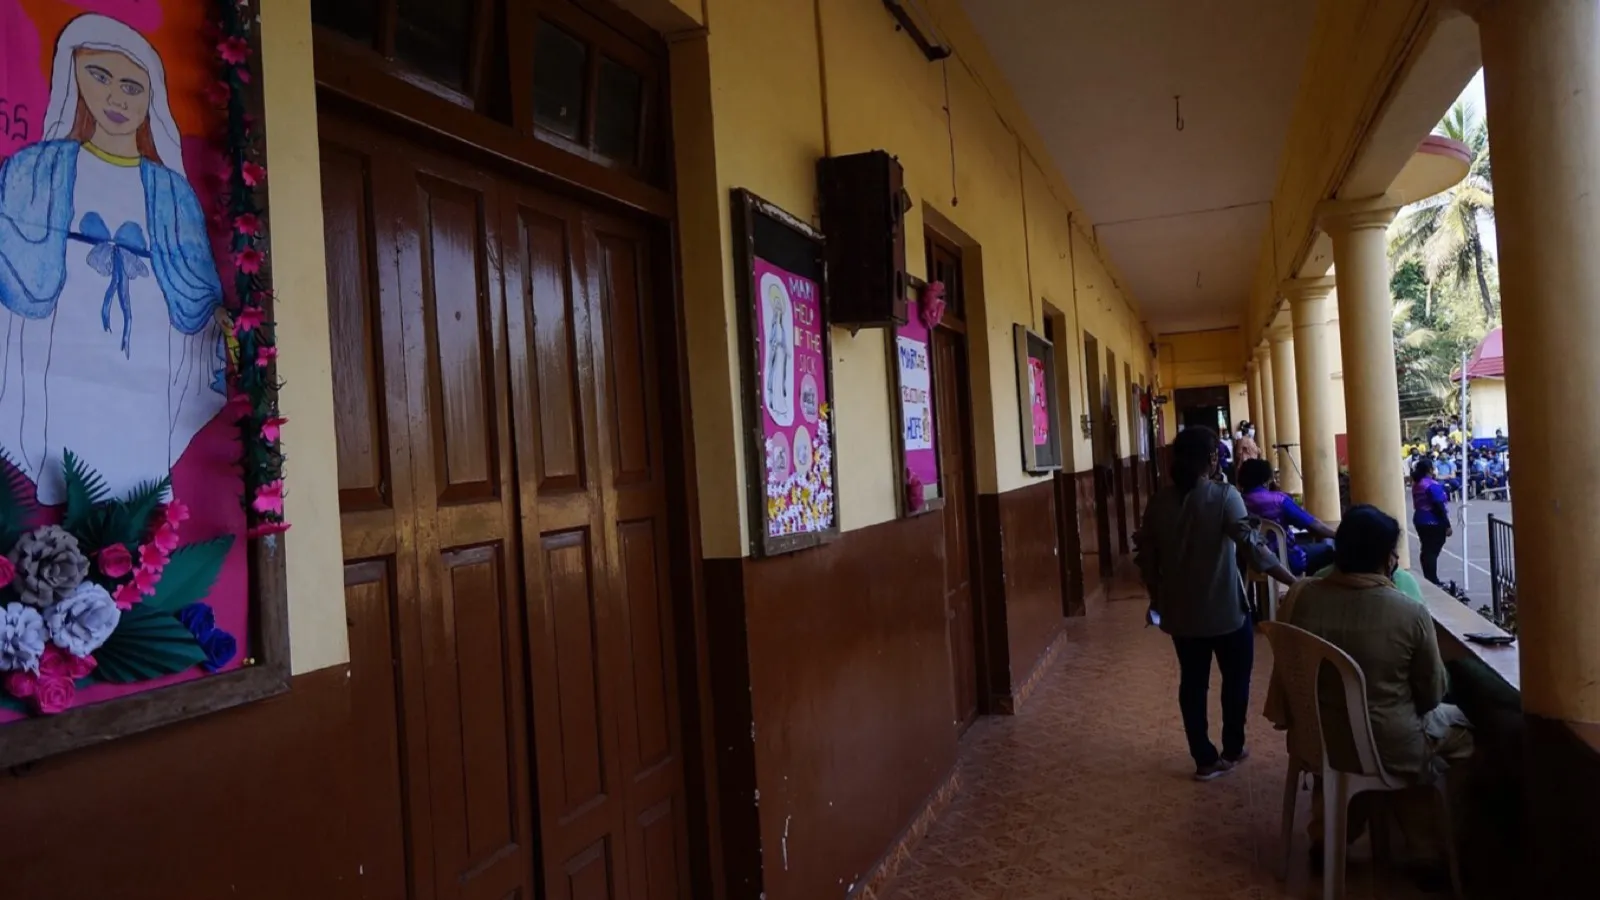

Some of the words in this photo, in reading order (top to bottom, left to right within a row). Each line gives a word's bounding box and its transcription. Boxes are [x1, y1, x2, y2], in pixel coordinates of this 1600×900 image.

[793, 302, 814, 326] HELP
[805, 330, 821, 354] THE
[799, 354, 817, 374] SICK
